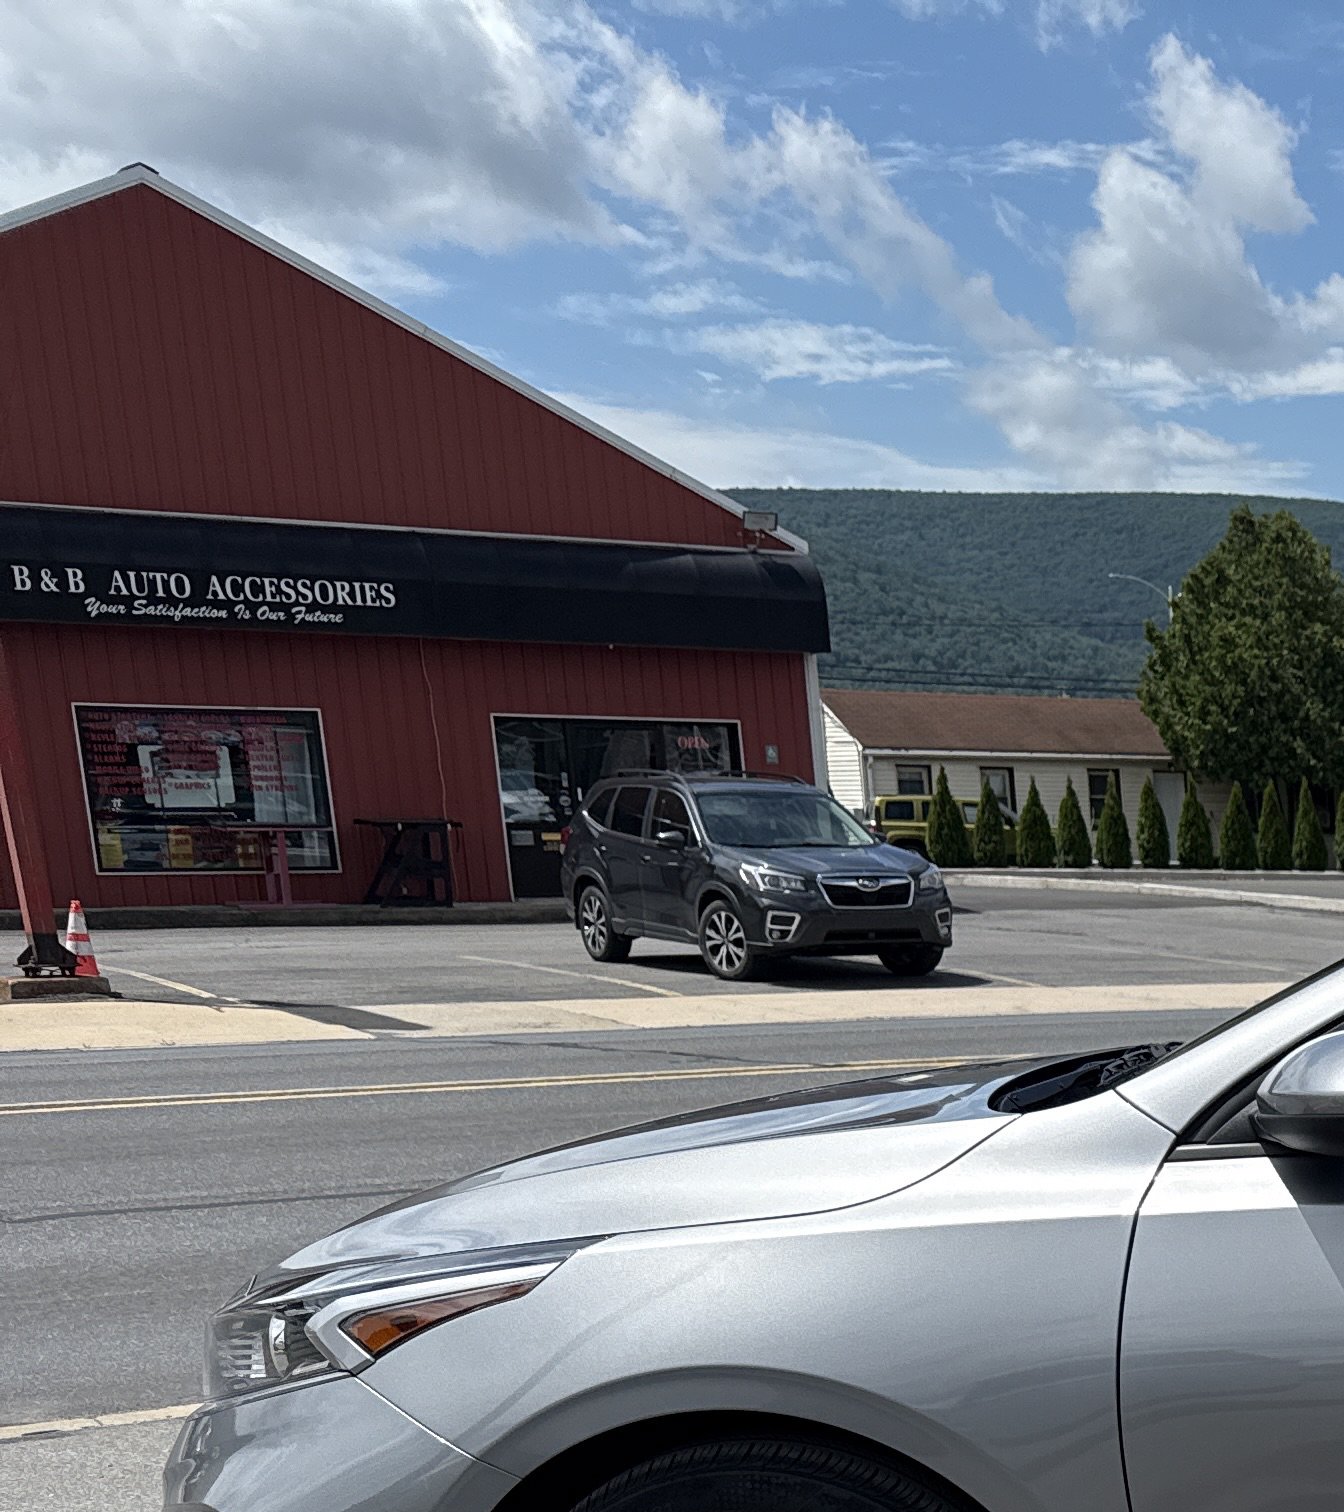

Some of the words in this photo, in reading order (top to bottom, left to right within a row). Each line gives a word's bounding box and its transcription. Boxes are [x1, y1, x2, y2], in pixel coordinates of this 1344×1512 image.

[10, 564, 32, 591] B
[40, 568, 60, 593] &
[64, 567, 86, 594] B
[108, 569, 191, 599] AUTO
[206, 574, 396, 608] ACCESSORIES
[84, 597, 127, 619] Your
[132, 600, 229, 622] Satisfaction
[234, 603, 251, 619] Is
[256, 605, 287, 621] Our
[291, 606, 344, 624] Future
